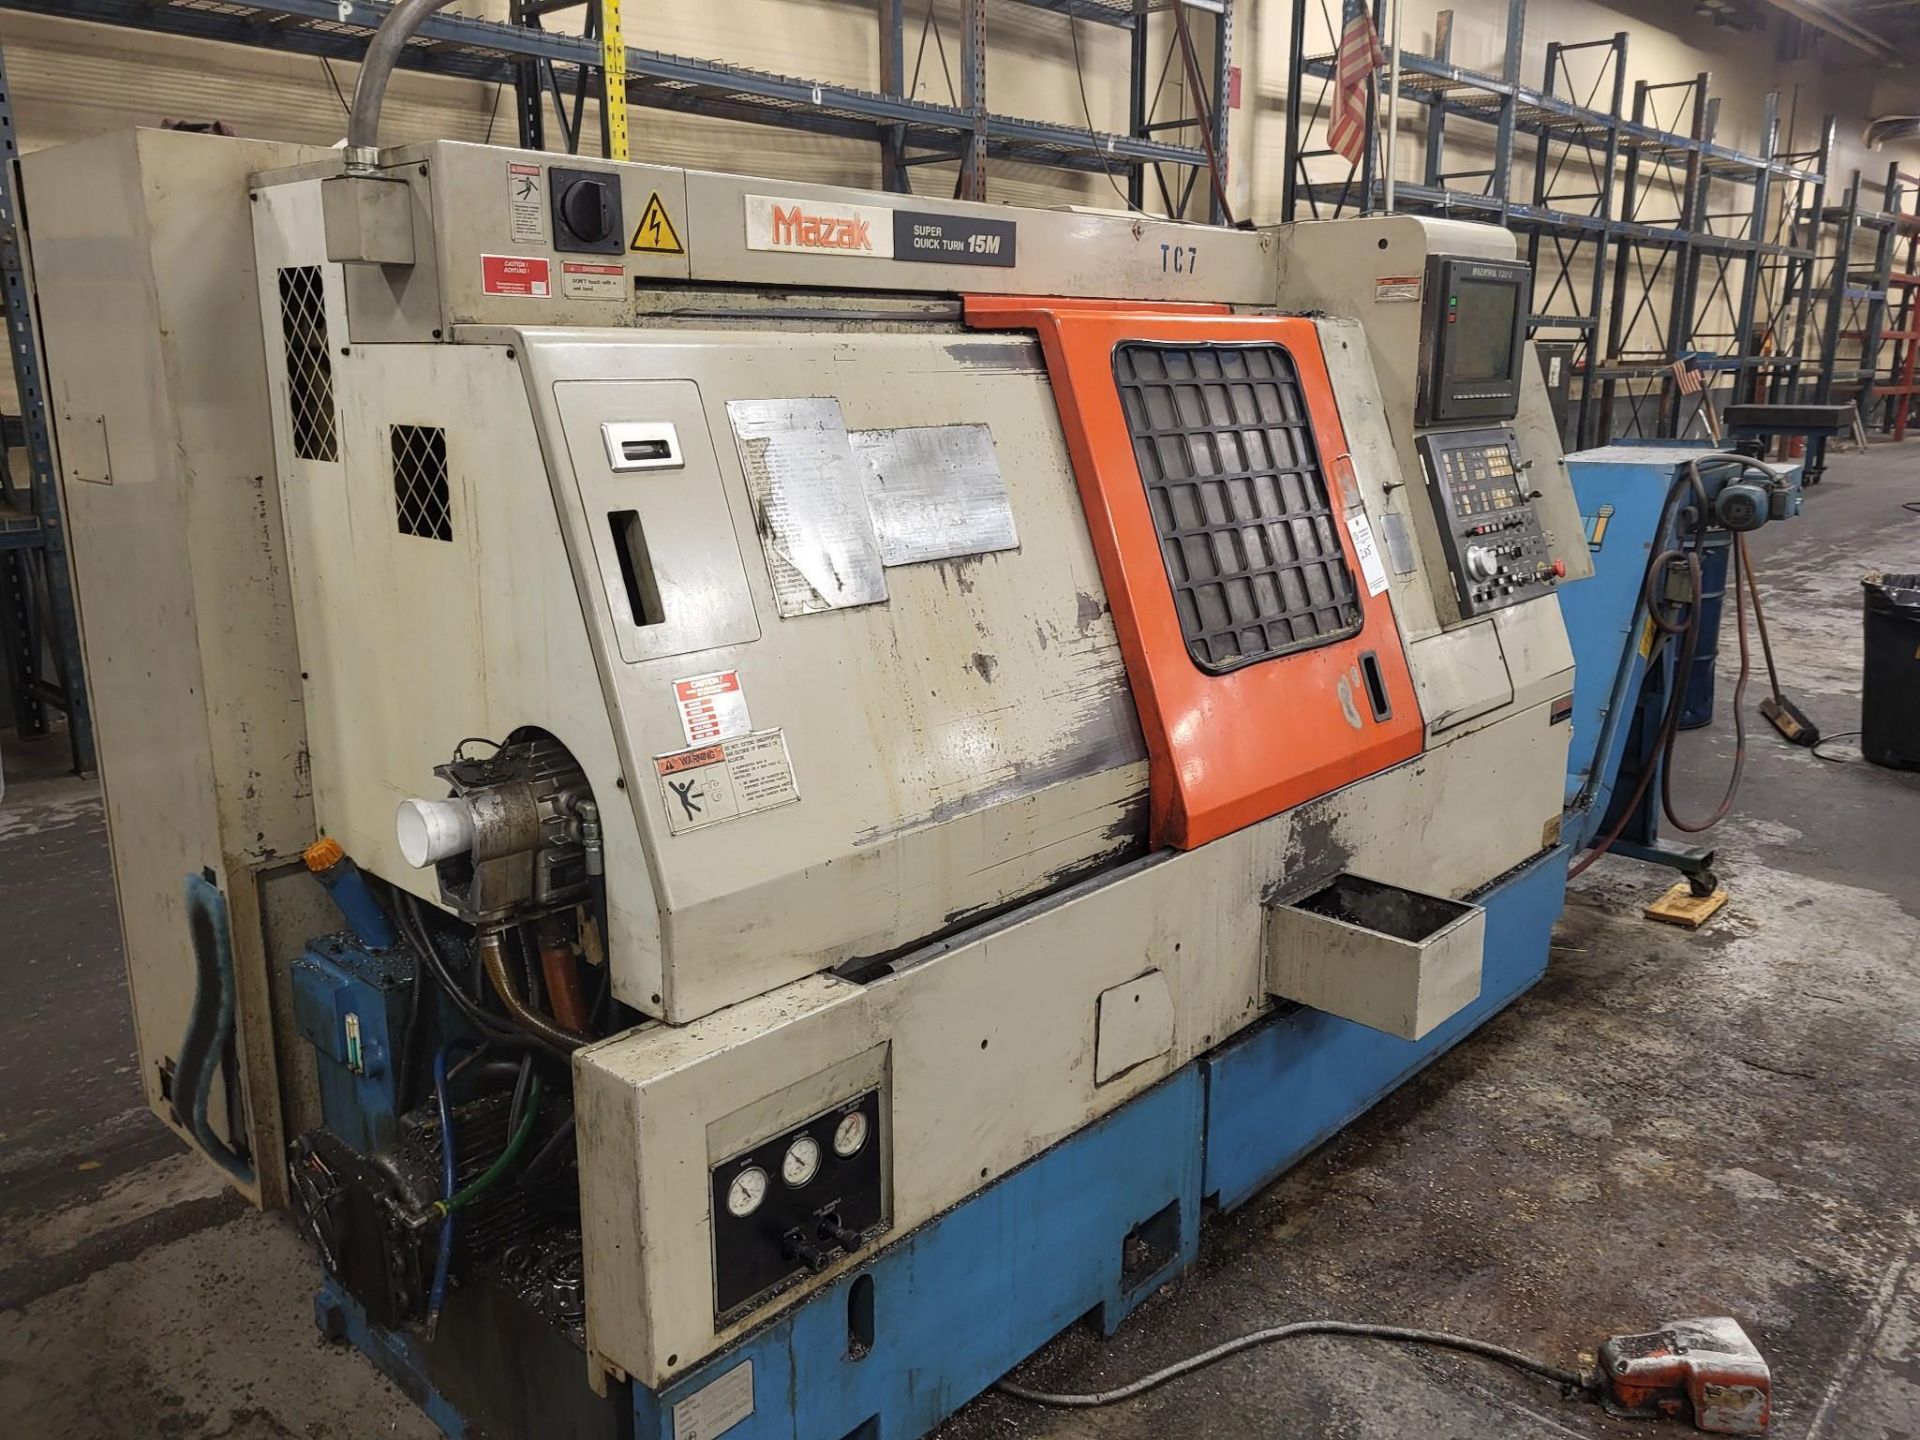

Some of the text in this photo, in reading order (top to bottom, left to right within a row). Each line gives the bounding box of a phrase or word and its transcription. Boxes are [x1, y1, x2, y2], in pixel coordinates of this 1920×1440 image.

[772, 203, 873, 251] Mazak
[913, 224, 943, 238] SUPER
[913, 234, 1001, 255] QUICK TURN 15M
[679, 750, 716, 767] WARNING
